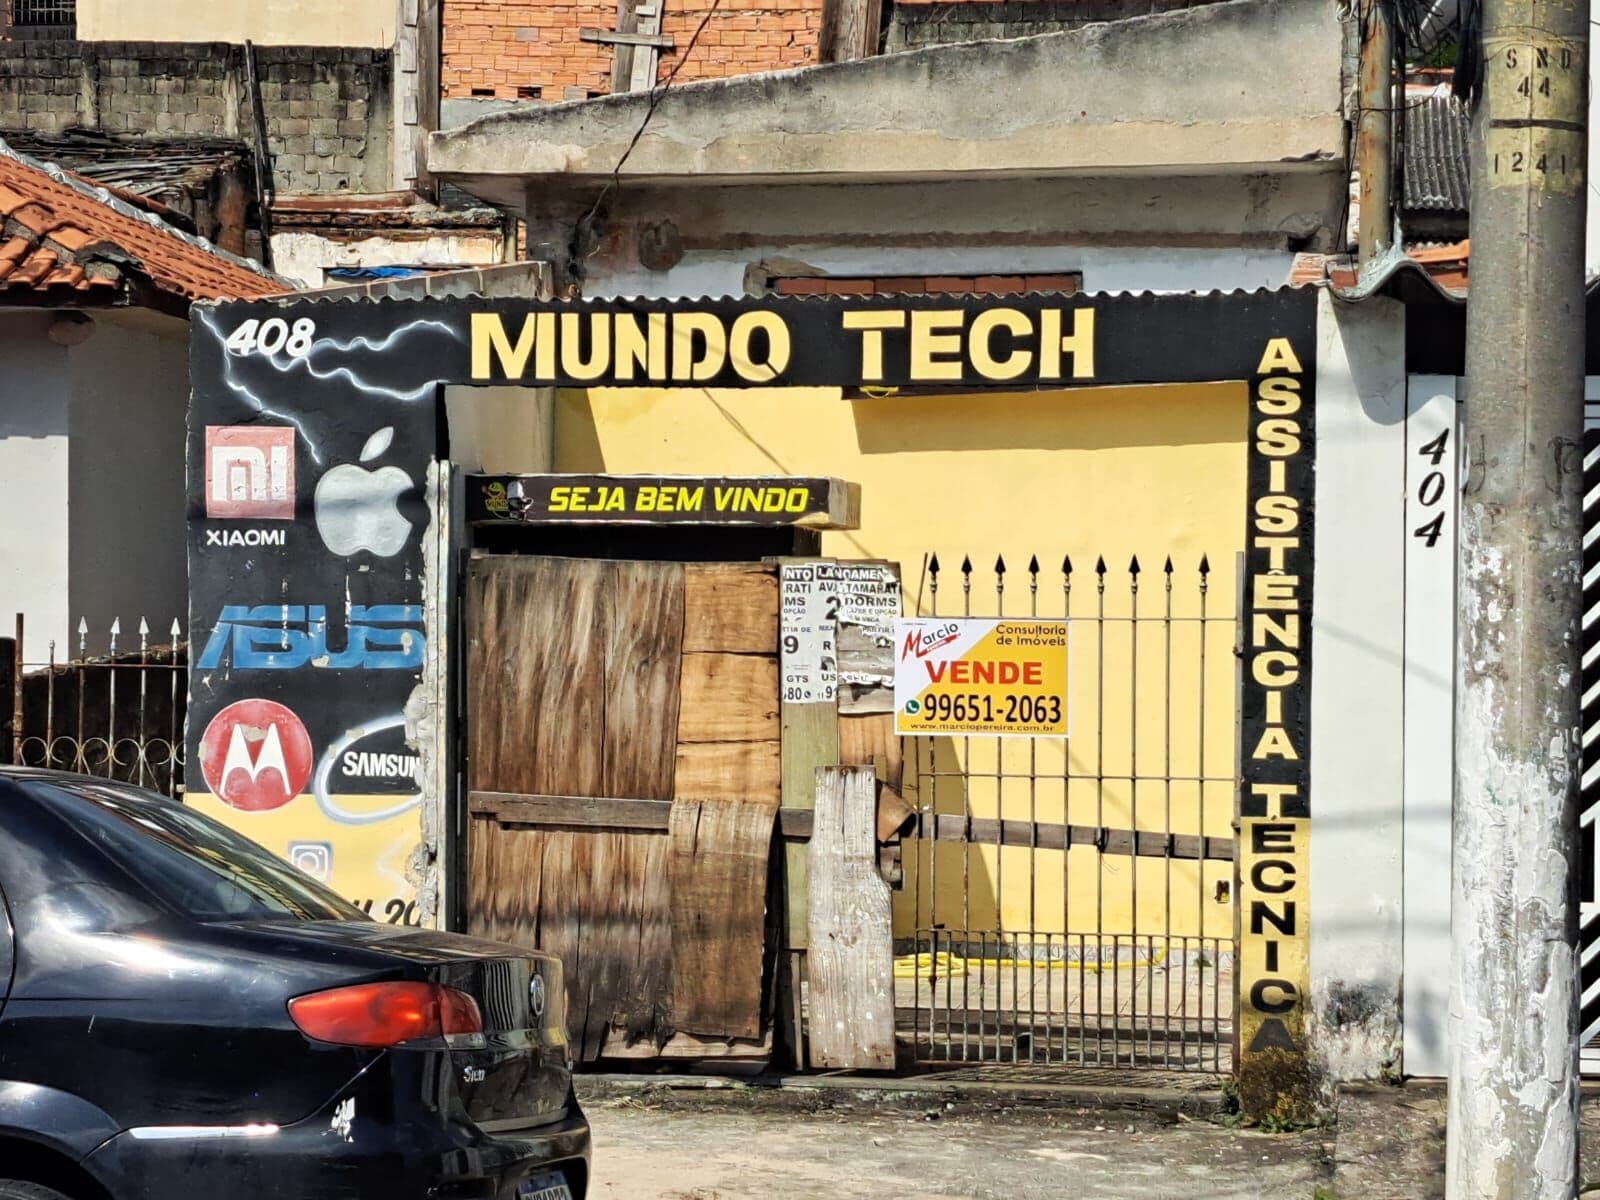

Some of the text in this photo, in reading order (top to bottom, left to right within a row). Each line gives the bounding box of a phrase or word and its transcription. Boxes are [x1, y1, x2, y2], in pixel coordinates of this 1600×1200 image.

[1517, 76, 1550, 98] 44
[1494, 151, 1566, 175] 1241
[225, 317, 316, 357] 408
[471, 308, 1096, 382] MUNDO TECH
[548, 486, 810, 513] SEJA BEM VINDO
[1413, 427, 1451, 548] 404
[206, 529, 286, 547] XIAOMI
[196, 604, 426, 669] ASUS
[902, 623, 958, 662] Marcio
[995, 624, 1066, 636] Consultoria
[995, 634, 1066, 647] de Imóveis
[783, 635, 800, 654] 9
[924, 660, 1043, 686] VENDE
[924, 693, 1062, 724] 99651-2063
